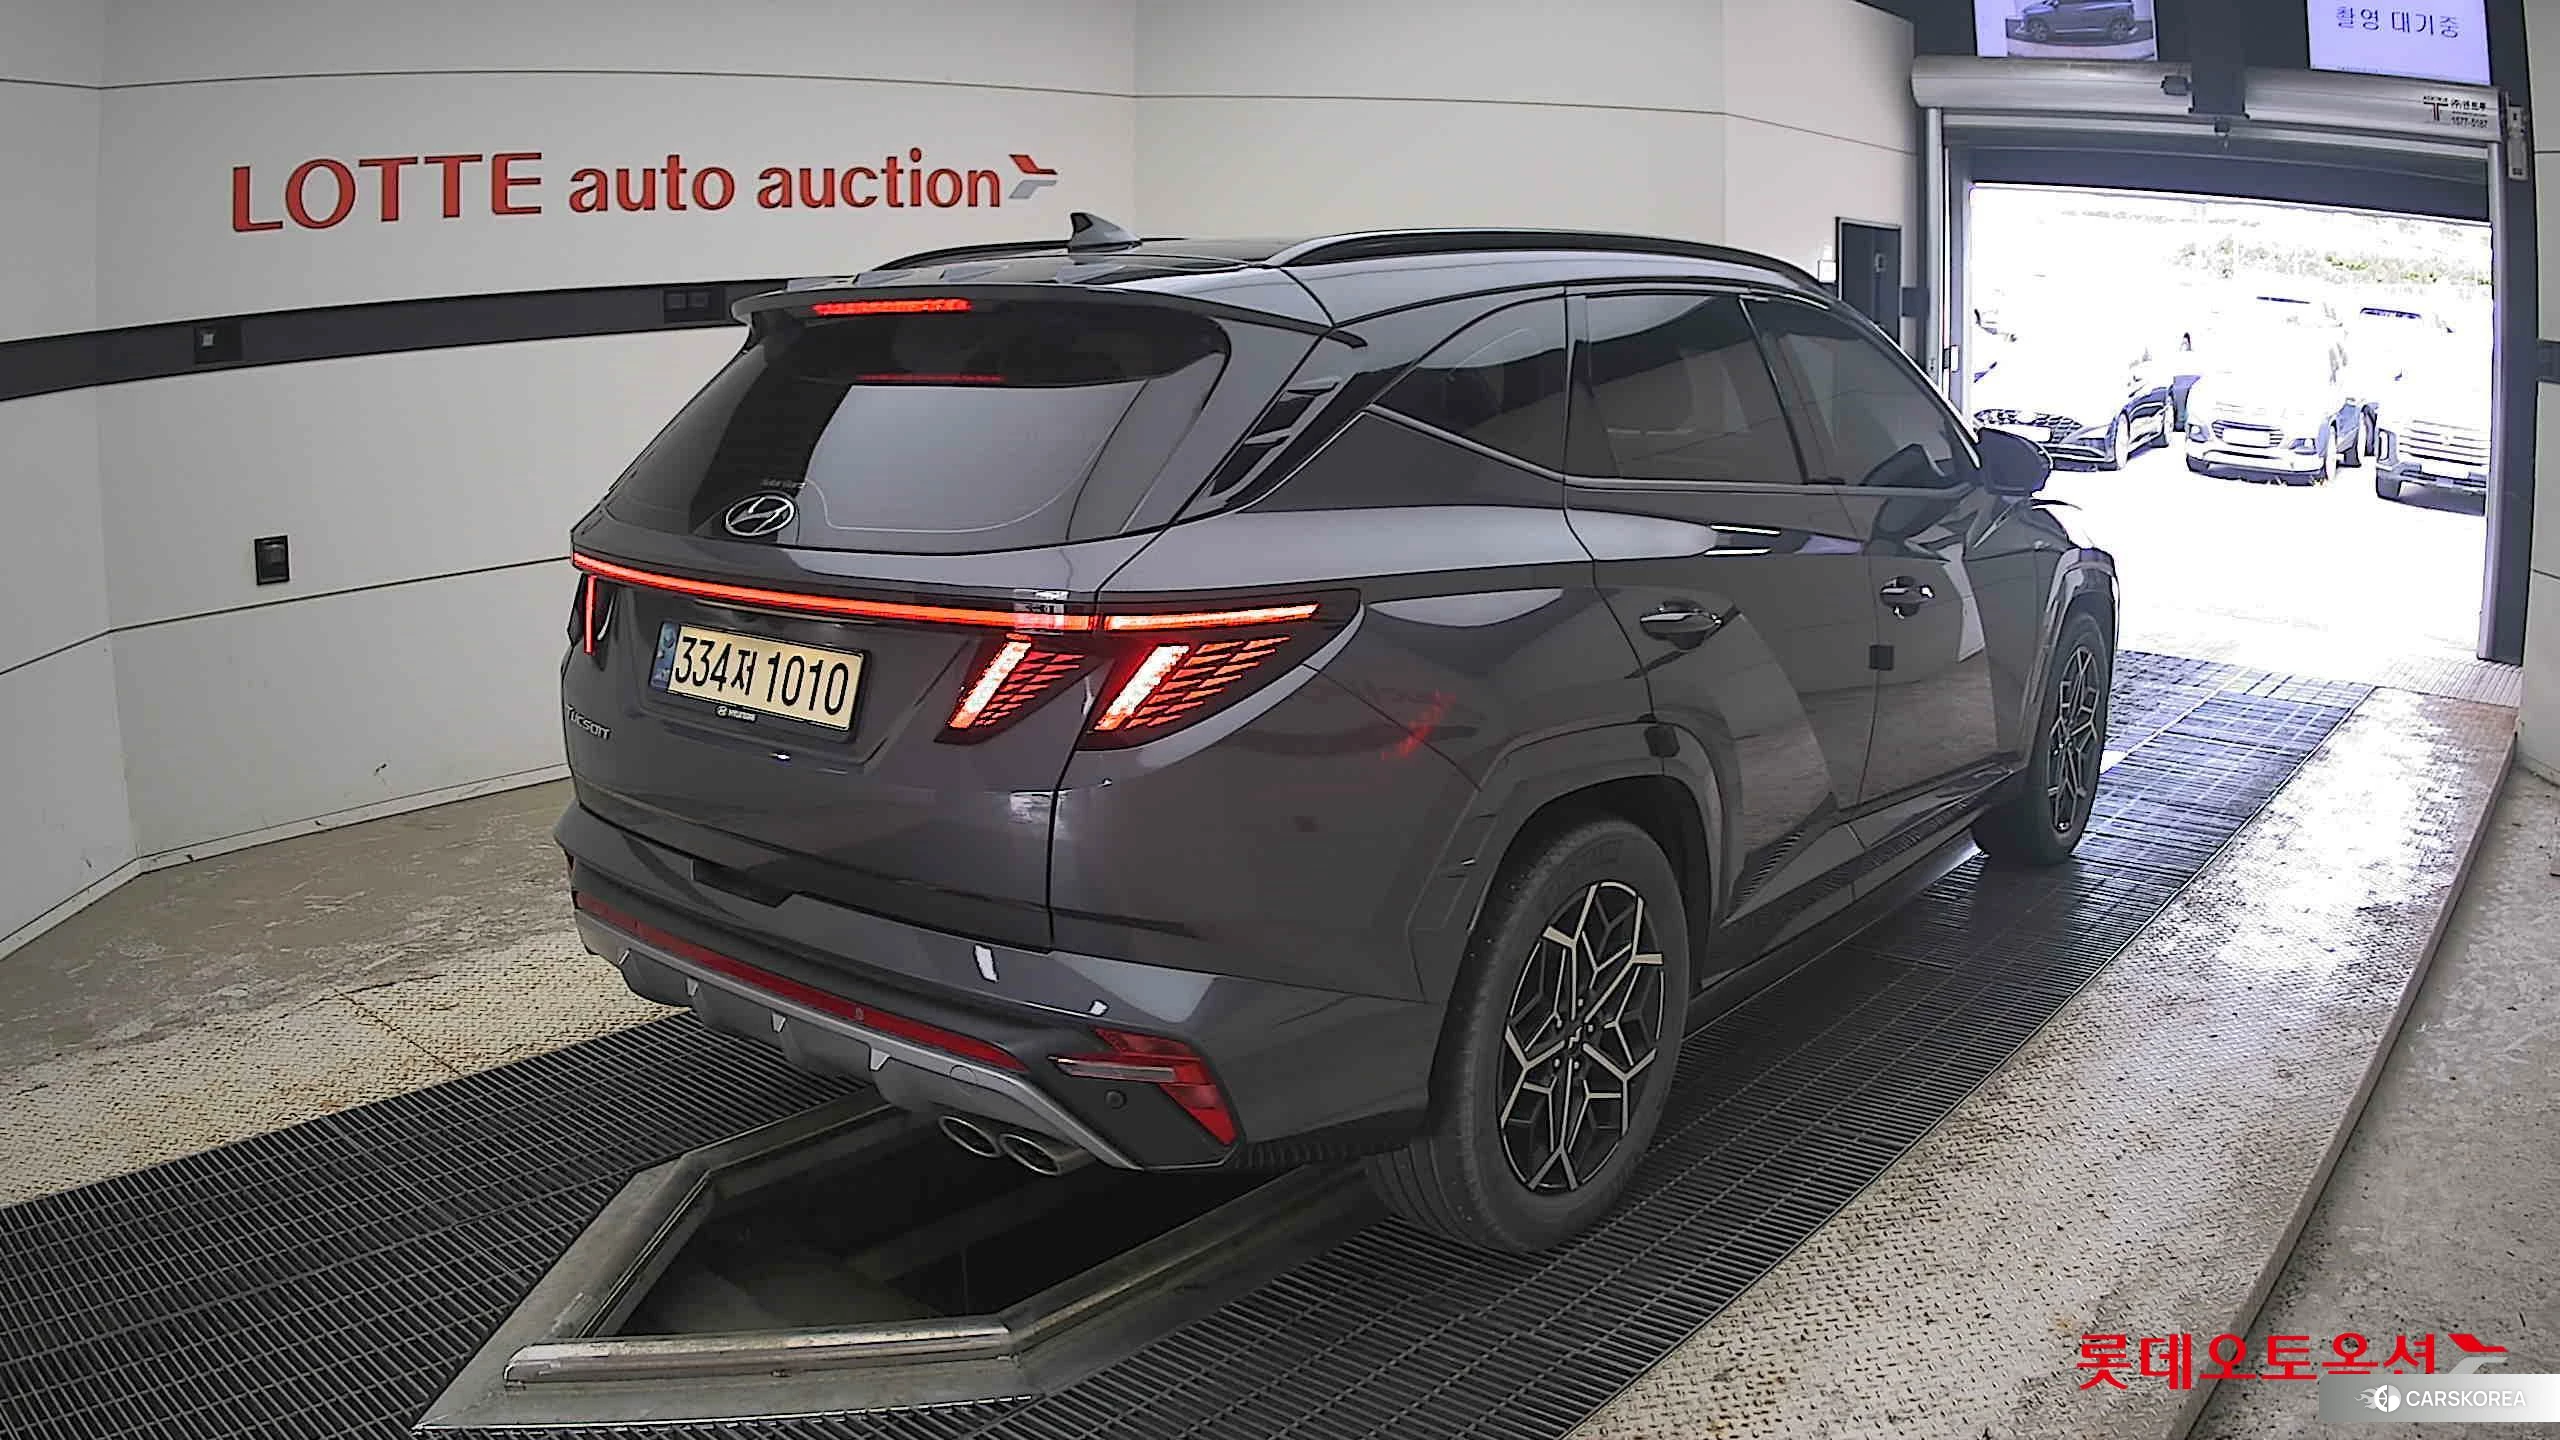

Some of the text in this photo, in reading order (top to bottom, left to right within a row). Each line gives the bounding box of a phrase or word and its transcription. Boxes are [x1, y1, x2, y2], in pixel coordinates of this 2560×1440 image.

[2336, 5, 2460, 39] 촬영 대기중
[232, 147, 1002, 233] LOTTE auto auction
[674, 636, 850, 716] 334저 1010
